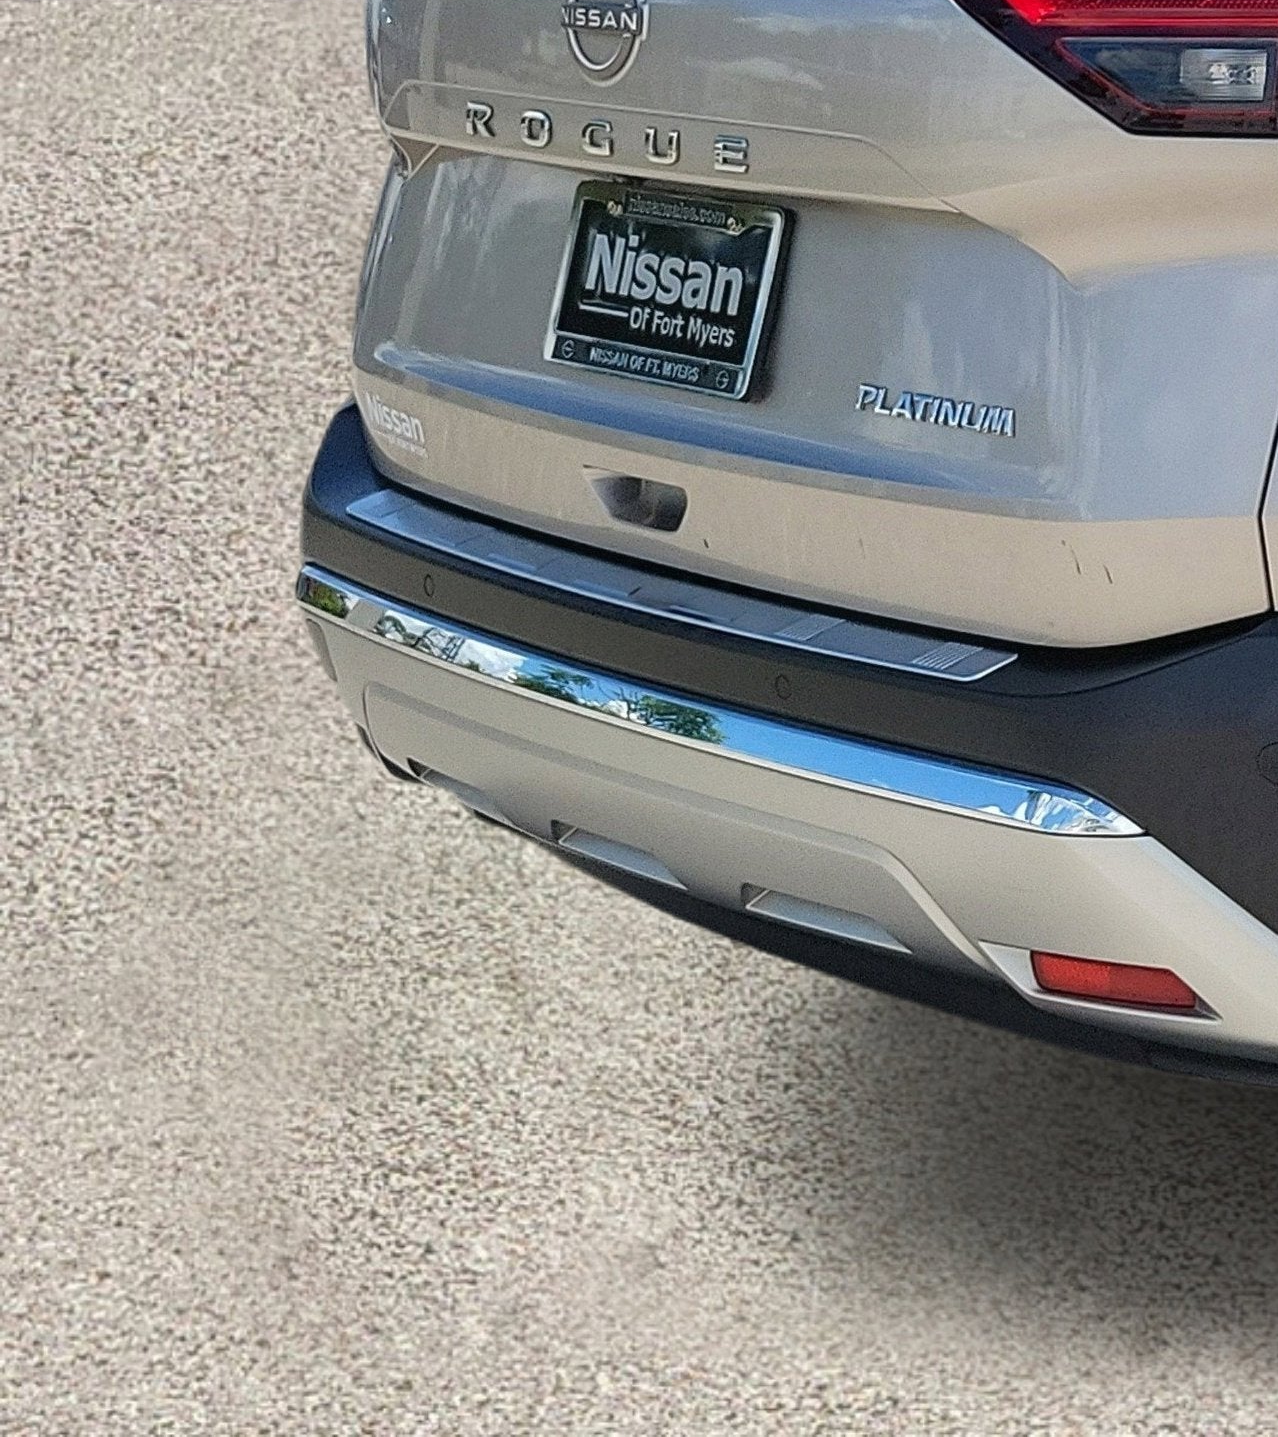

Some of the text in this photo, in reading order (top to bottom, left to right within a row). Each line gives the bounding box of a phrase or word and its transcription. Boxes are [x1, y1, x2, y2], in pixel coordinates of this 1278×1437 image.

[561, 7, 638, 32] NISSAN
[465, 100, 749, 173] ROGUE
[585, 233, 743, 315] Nissan
[629, 306, 735, 348] Of Fort Myers
[589, 347, 628, 367] NISSAN
[628, 354, 644, 371] OF
[662, 359, 700, 382] MYERS
[364, 392, 425, 443] Nissan
[855, 383, 1016, 437] PLATINUM
